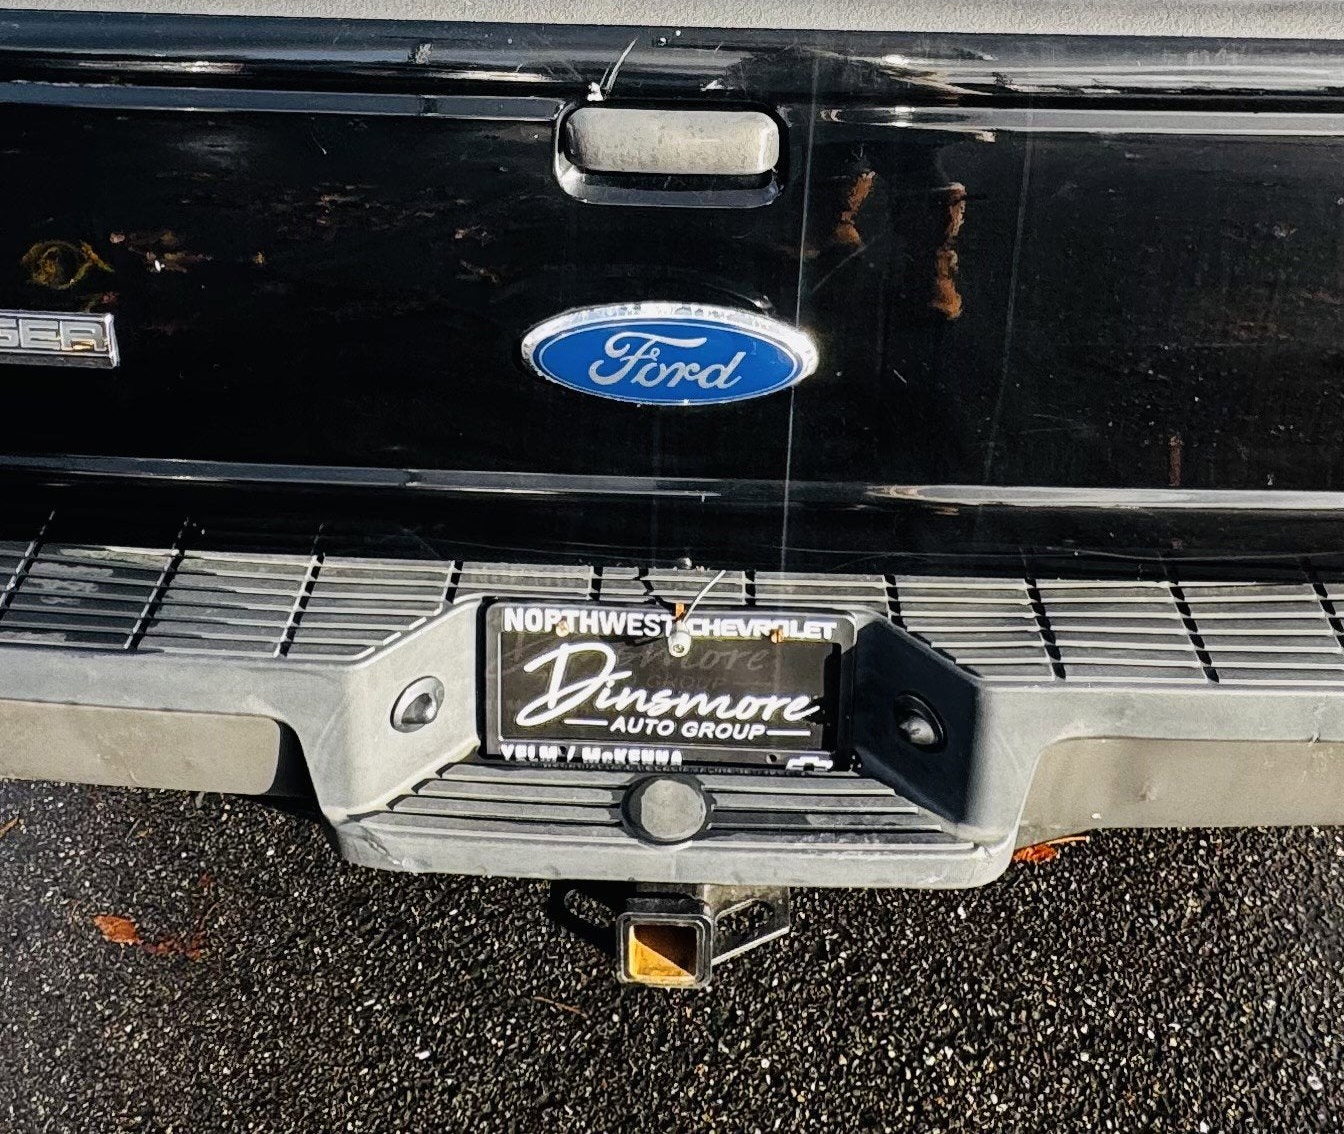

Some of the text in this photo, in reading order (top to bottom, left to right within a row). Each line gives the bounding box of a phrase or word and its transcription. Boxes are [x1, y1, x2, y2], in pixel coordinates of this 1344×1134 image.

[588, 331, 747, 390] Ford
[503, 607, 837, 640] NORTHWEST CHEVROLET
[513, 641, 821, 728] Dinsmore
[609, 715, 766, 741] AUTO GROUP
